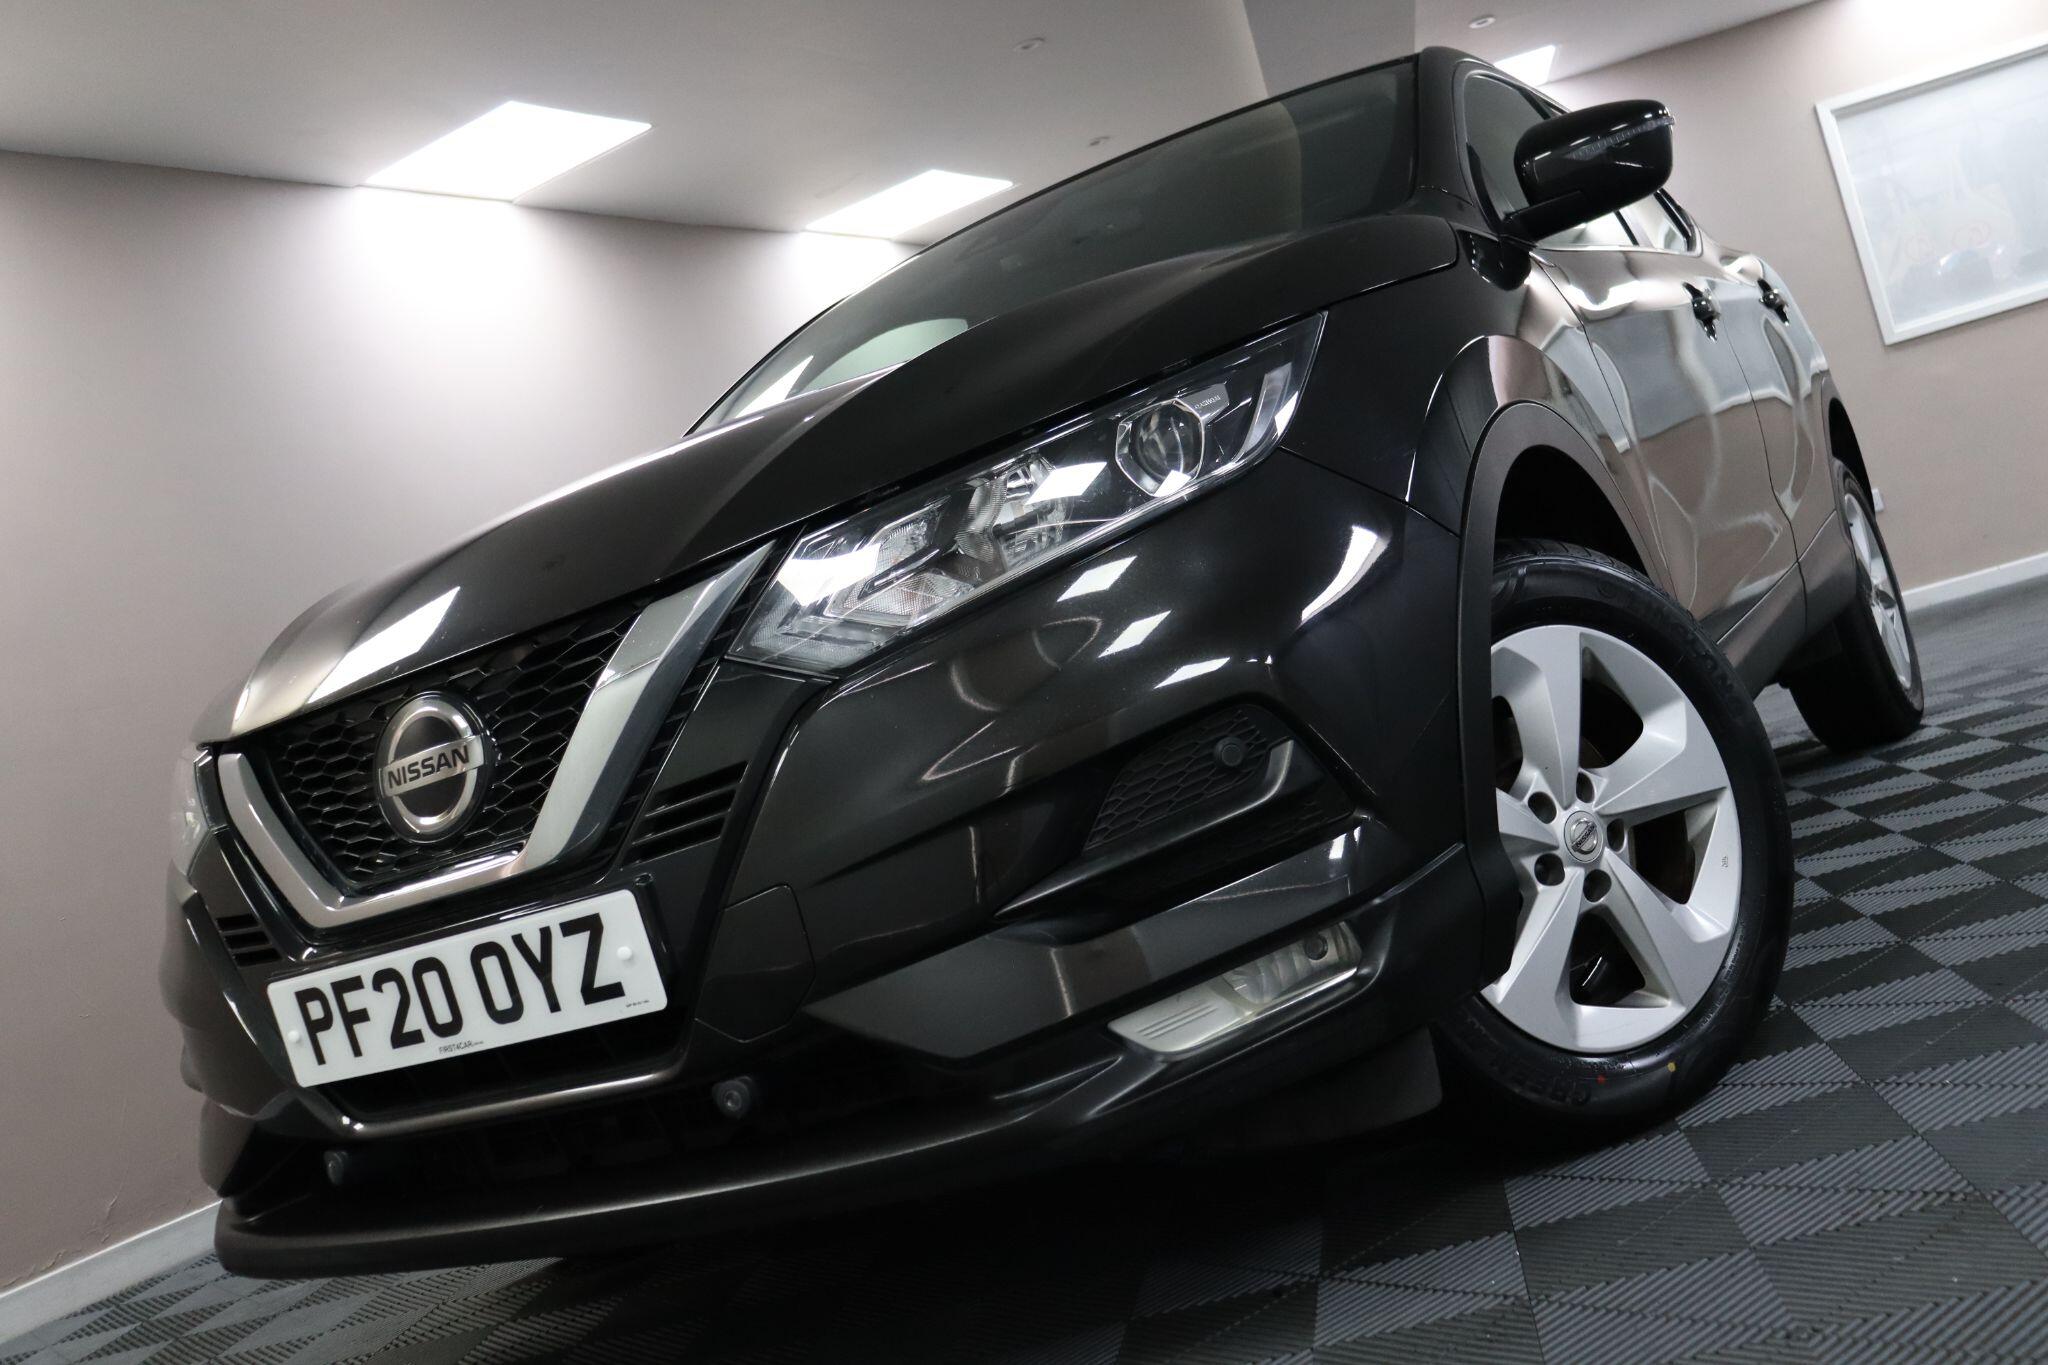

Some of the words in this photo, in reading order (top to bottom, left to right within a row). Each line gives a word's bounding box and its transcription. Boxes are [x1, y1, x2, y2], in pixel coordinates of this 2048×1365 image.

[388, 746, 470, 789] NISSAN
[294, 957, 463, 1065] PF20
[470, 912, 626, 1025] OYZ
